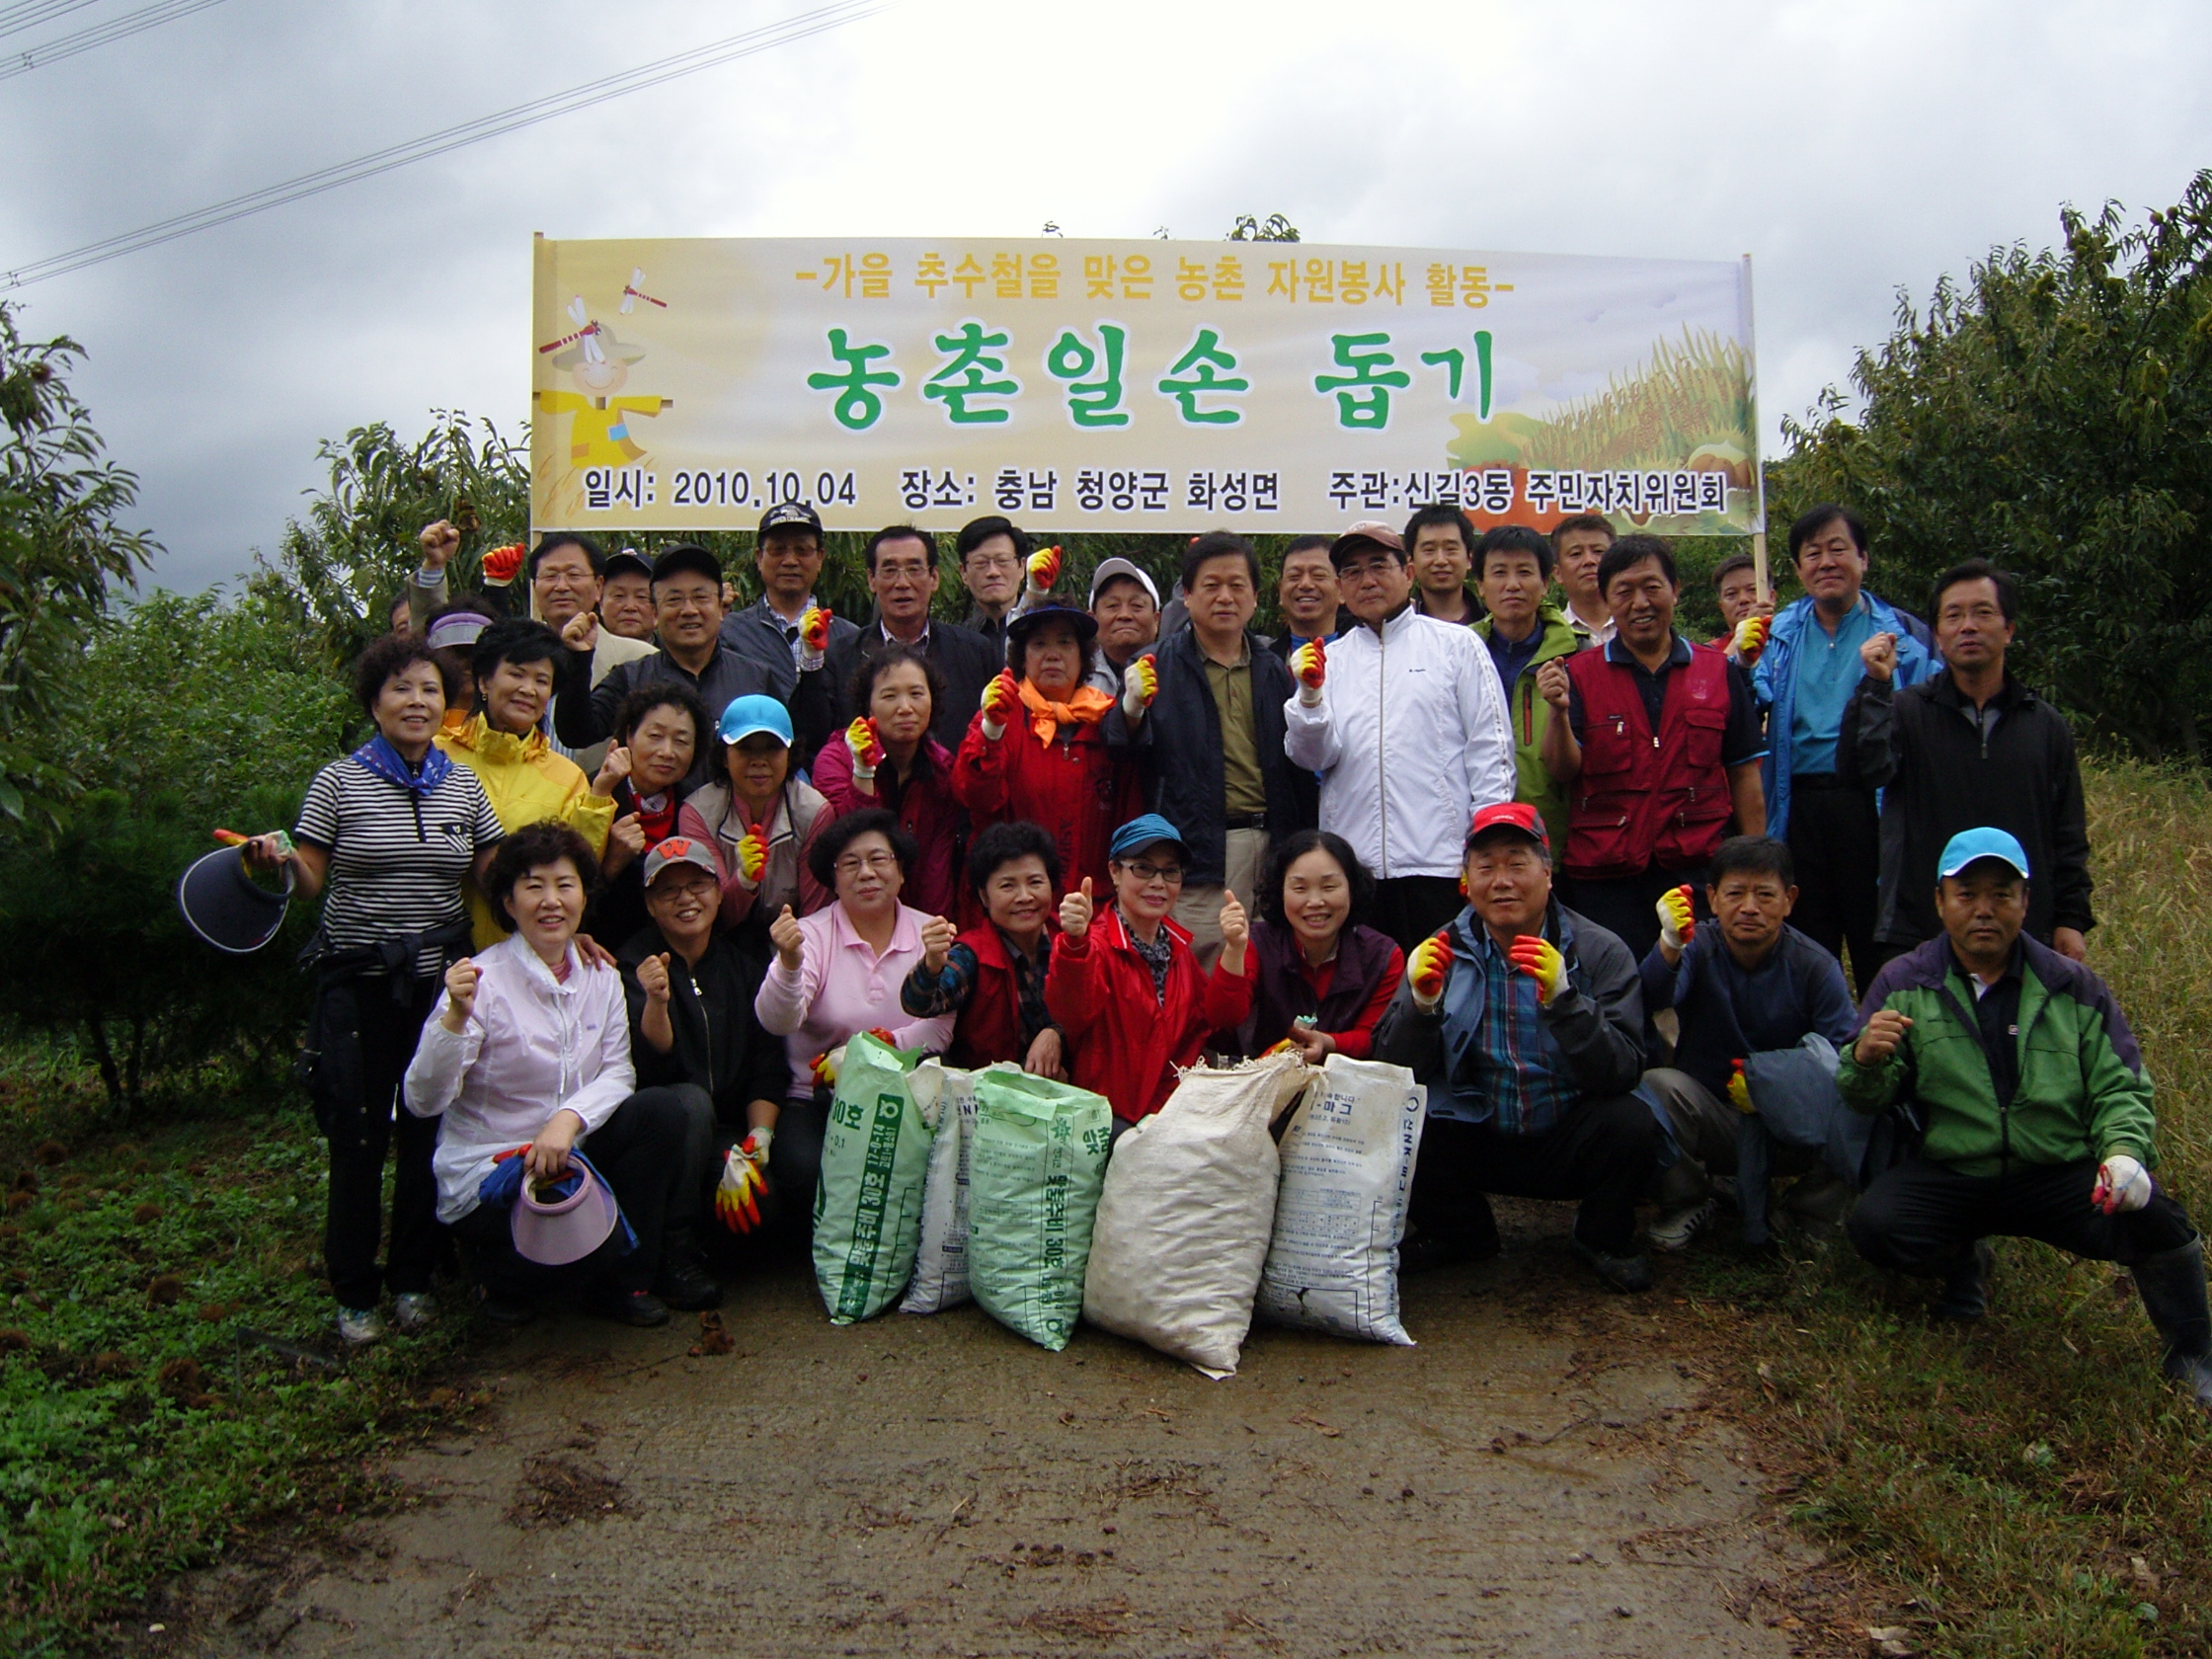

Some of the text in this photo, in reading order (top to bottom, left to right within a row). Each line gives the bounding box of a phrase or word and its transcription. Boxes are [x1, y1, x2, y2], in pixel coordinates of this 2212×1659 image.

[796, 253, 1514, 308] -가을 추수철을 맞은 농촌 자원봉사 활동-
[1315, 331, 1493, 430] 돕기
[585, 469, 654, 508] 일시:
[675, 471, 855, 509] 2010.10.04
[902, 470, 974, 508] 장소:
[995, 470, 1057, 509] 충남
[1076, 470, 1168, 509] 청양군
[1189, 471, 1278, 510] 화성면
[1529, 472, 1726, 513] 주민자치위원회
[658, 839, 691, 859] W
[867, 1123, 886, 1166] 17-0-14
[861, 1171, 886, 1207] 30호
[1044, 1238, 1065, 1269] 30호
